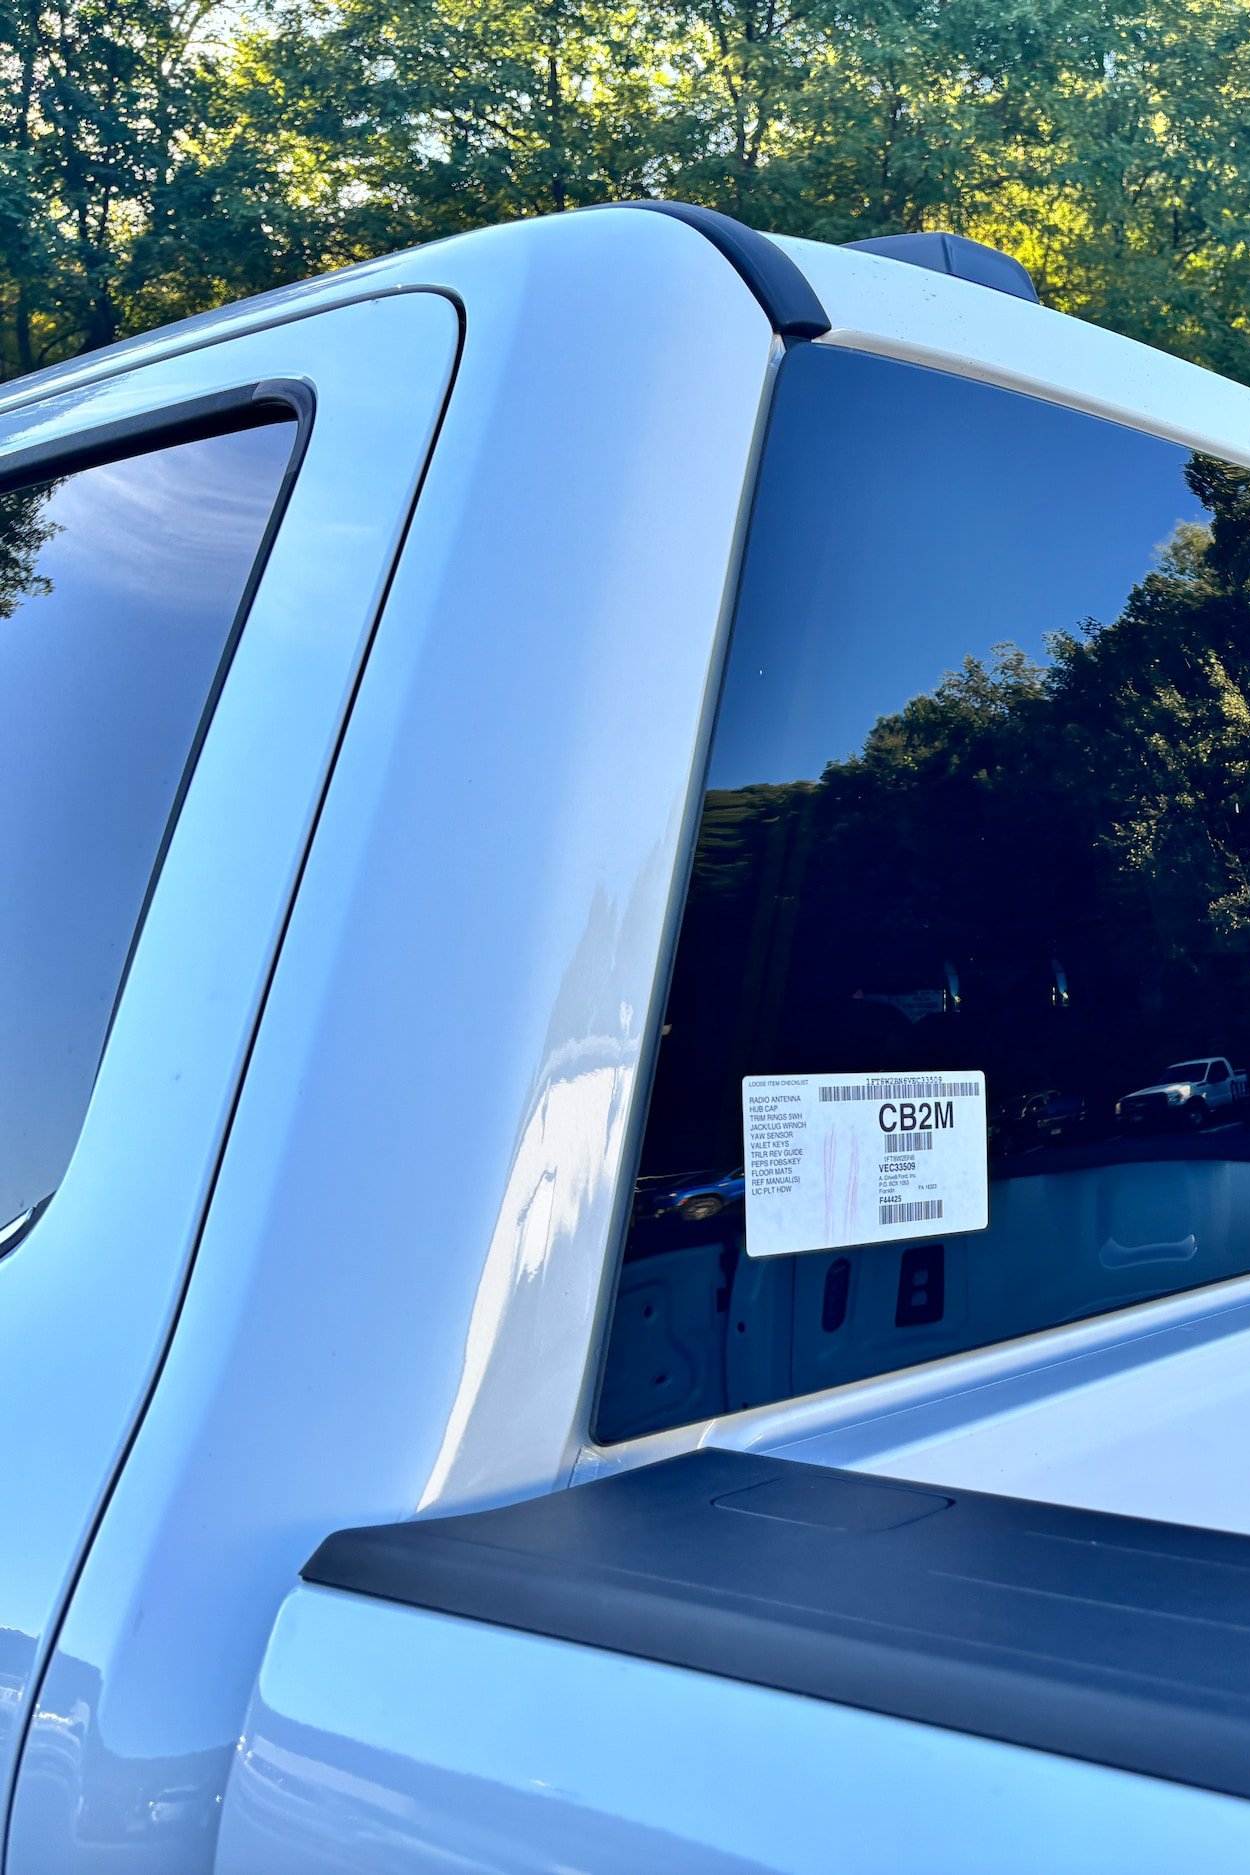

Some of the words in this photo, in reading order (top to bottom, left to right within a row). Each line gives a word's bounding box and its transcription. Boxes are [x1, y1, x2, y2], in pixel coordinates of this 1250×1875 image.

[767, 1113, 787, 1121] RINGS
[879, 1101, 954, 1133] CB2M
[750, 1123, 781, 1131] JACK/LUG
[767, 1131, 793, 1139] SENSOR
[772, 1140, 789, 1148] KEYS
[752, 1160, 768, 1168] PEPS
[879, 1162, 915, 1172] VEC33509
[752, 1169, 773, 1177] FLOOR
[766, 1176, 800, 1184] MANUAL(S)
[880, 1195, 902, 1204] F44425
